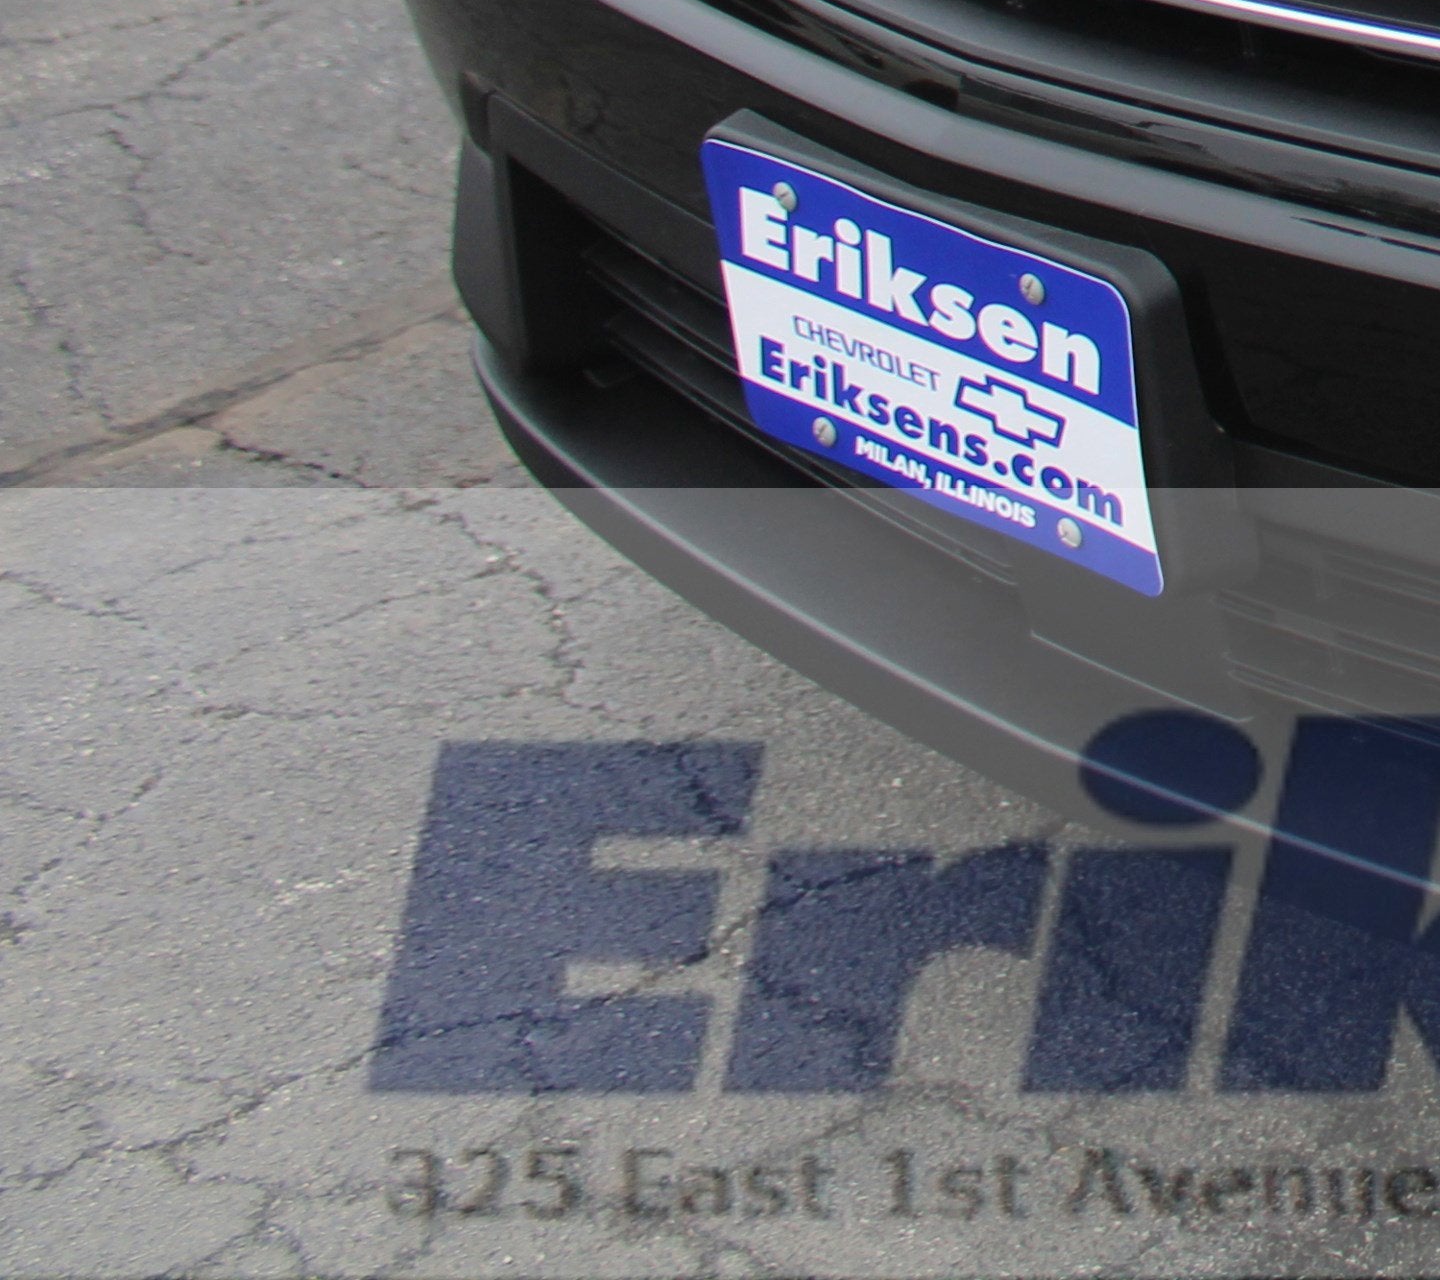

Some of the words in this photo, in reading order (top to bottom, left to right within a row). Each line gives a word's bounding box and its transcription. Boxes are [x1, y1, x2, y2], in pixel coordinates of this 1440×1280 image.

[739, 187, 1100, 395] Eriksen
[792, 315, 941, 392] CHEVROLET
[759, 335, 1123, 527] Eriksens.com
[855, 435, 933, 490] MILAN,
[934, 471, 1037, 528] ILLINOIS
